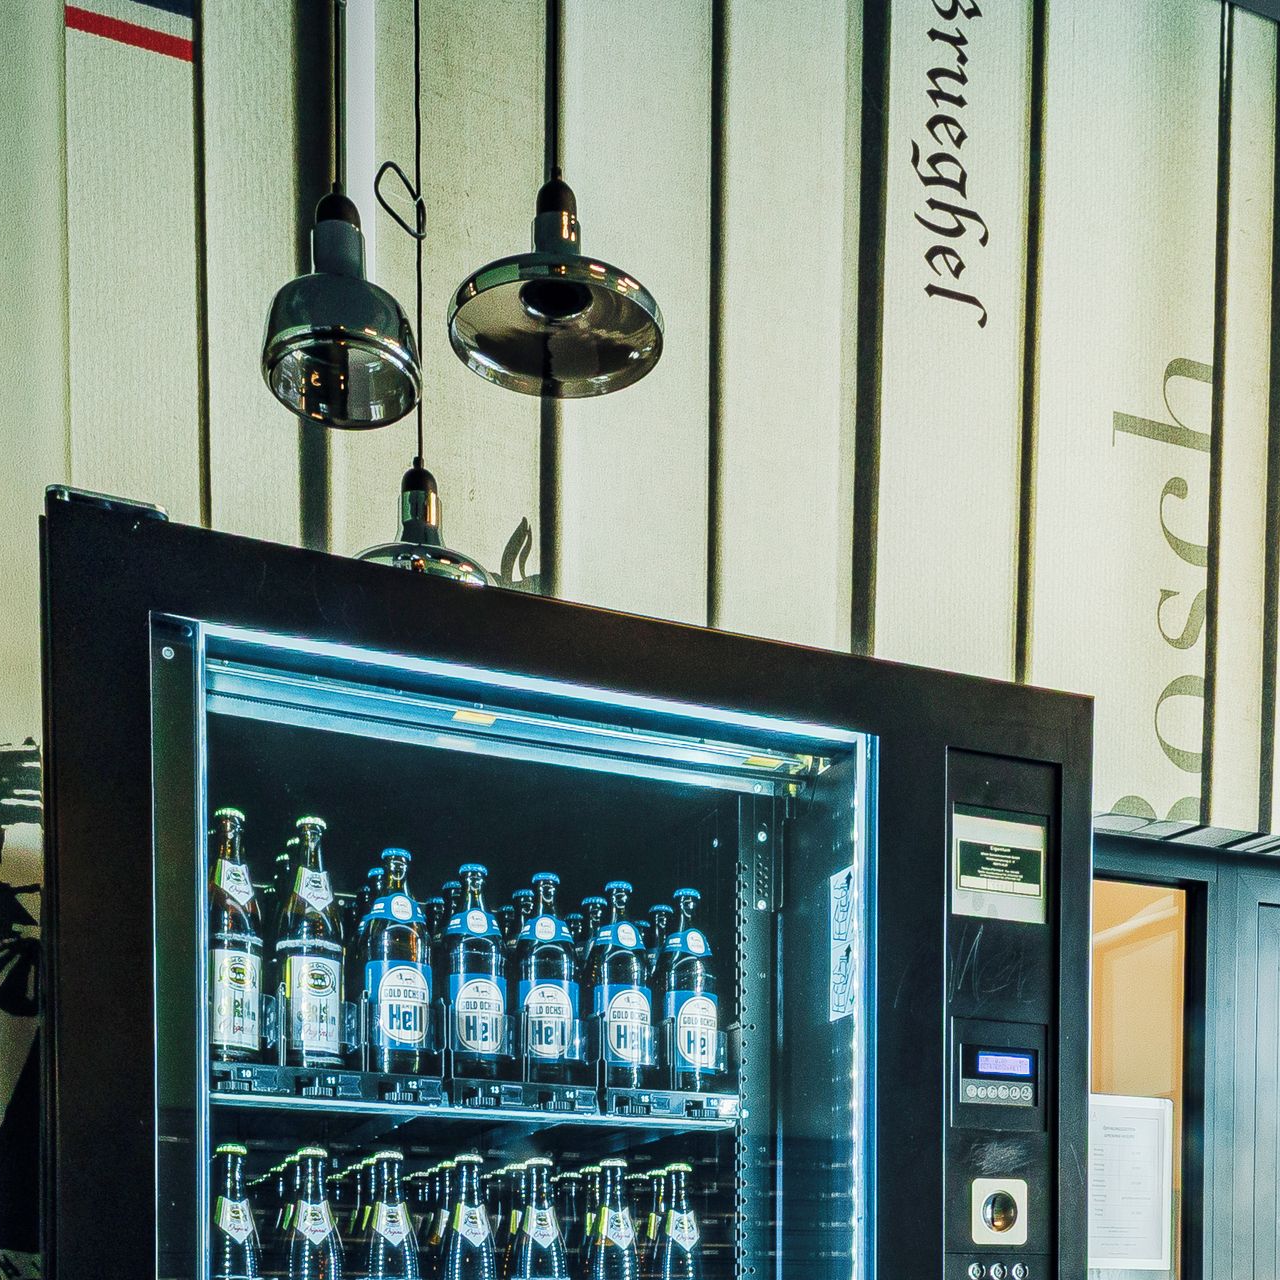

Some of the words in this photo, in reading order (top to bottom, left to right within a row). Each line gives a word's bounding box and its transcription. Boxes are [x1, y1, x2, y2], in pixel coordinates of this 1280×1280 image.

[1110, 356, 1215, 821] osch
[388, 1003, 424, 1032] Hell
[241, 1069, 252, 1078] 10
[326, 1076, 336, 1084] 11
[407, 1081, 418, 1089] 12
[490, 1086, 500, 1094] 13
[565, 1091, 574, 1099] 14
[641, 1095, 650, 1103] 15
